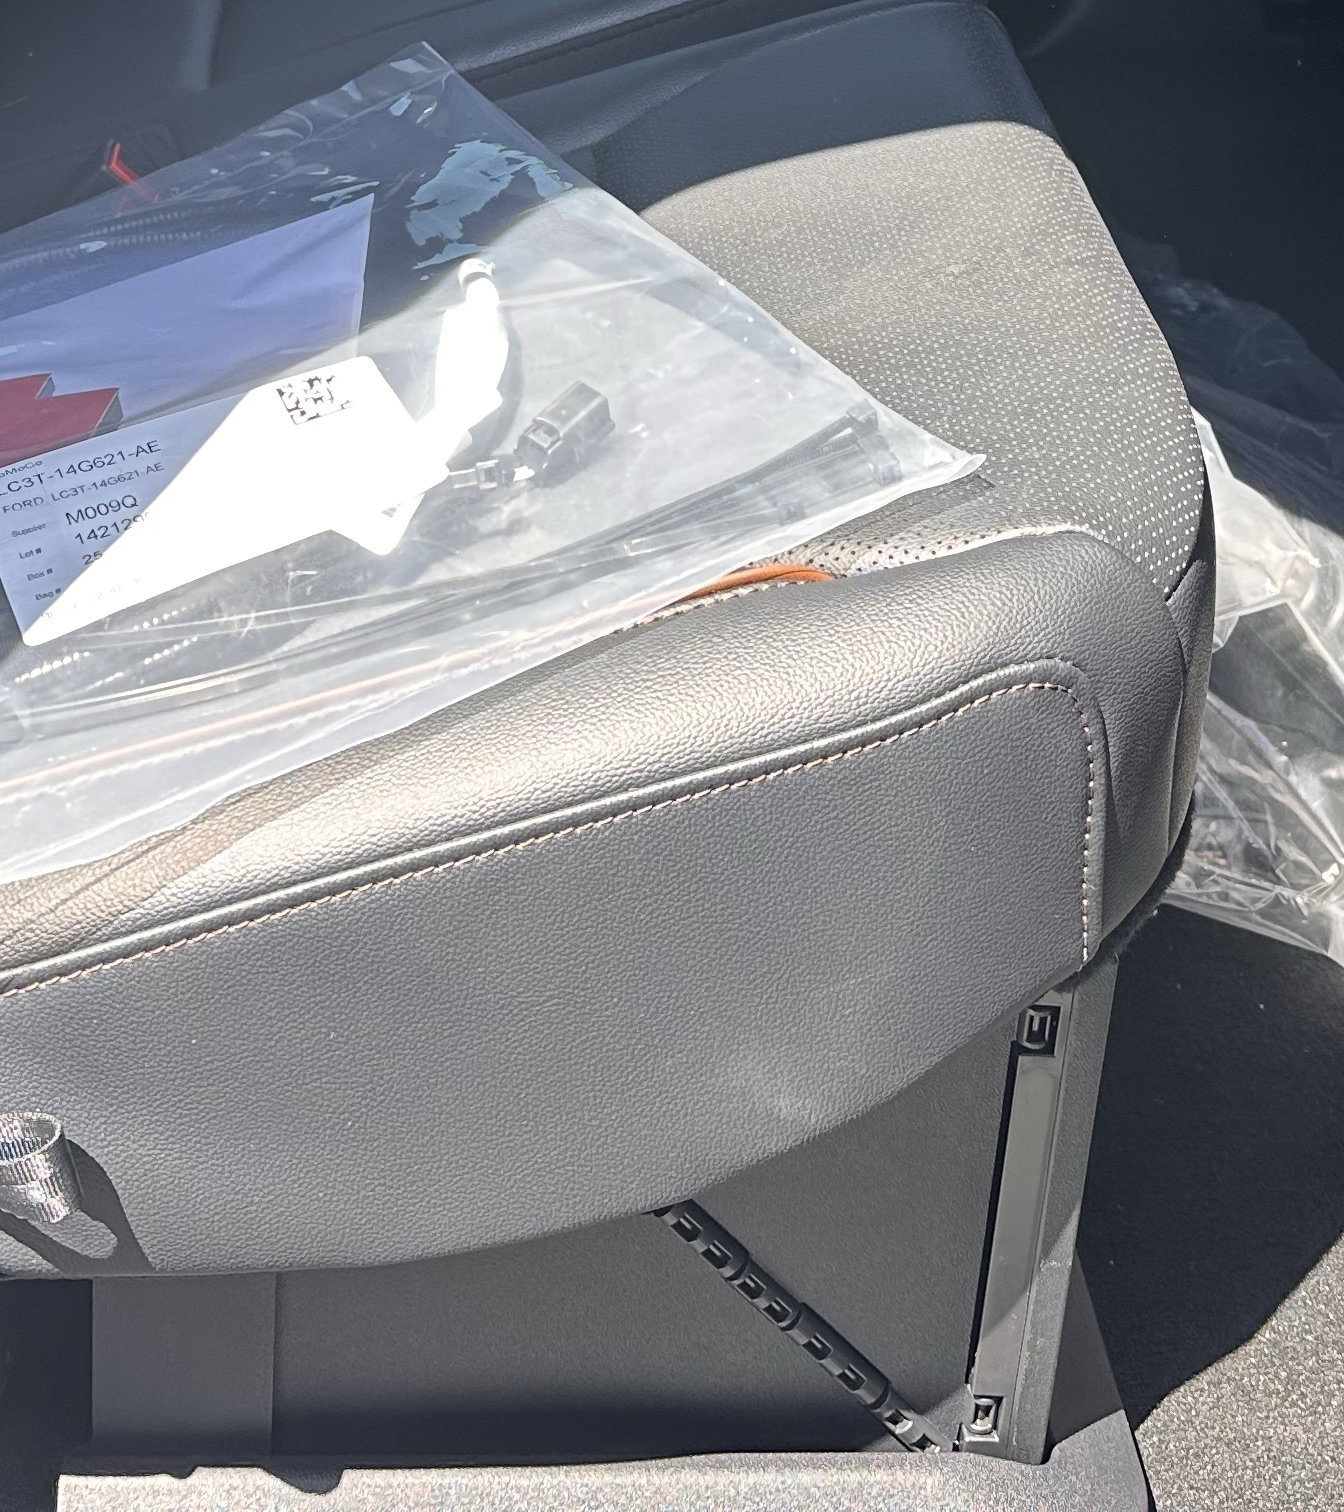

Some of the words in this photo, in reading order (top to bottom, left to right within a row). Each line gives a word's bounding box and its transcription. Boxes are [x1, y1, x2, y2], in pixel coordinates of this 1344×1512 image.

[2, 496, 44, 514] FORD
[51, 462, 165, 502] LC3T-14G621-AE
[65, 494, 139, 525] M009Q
